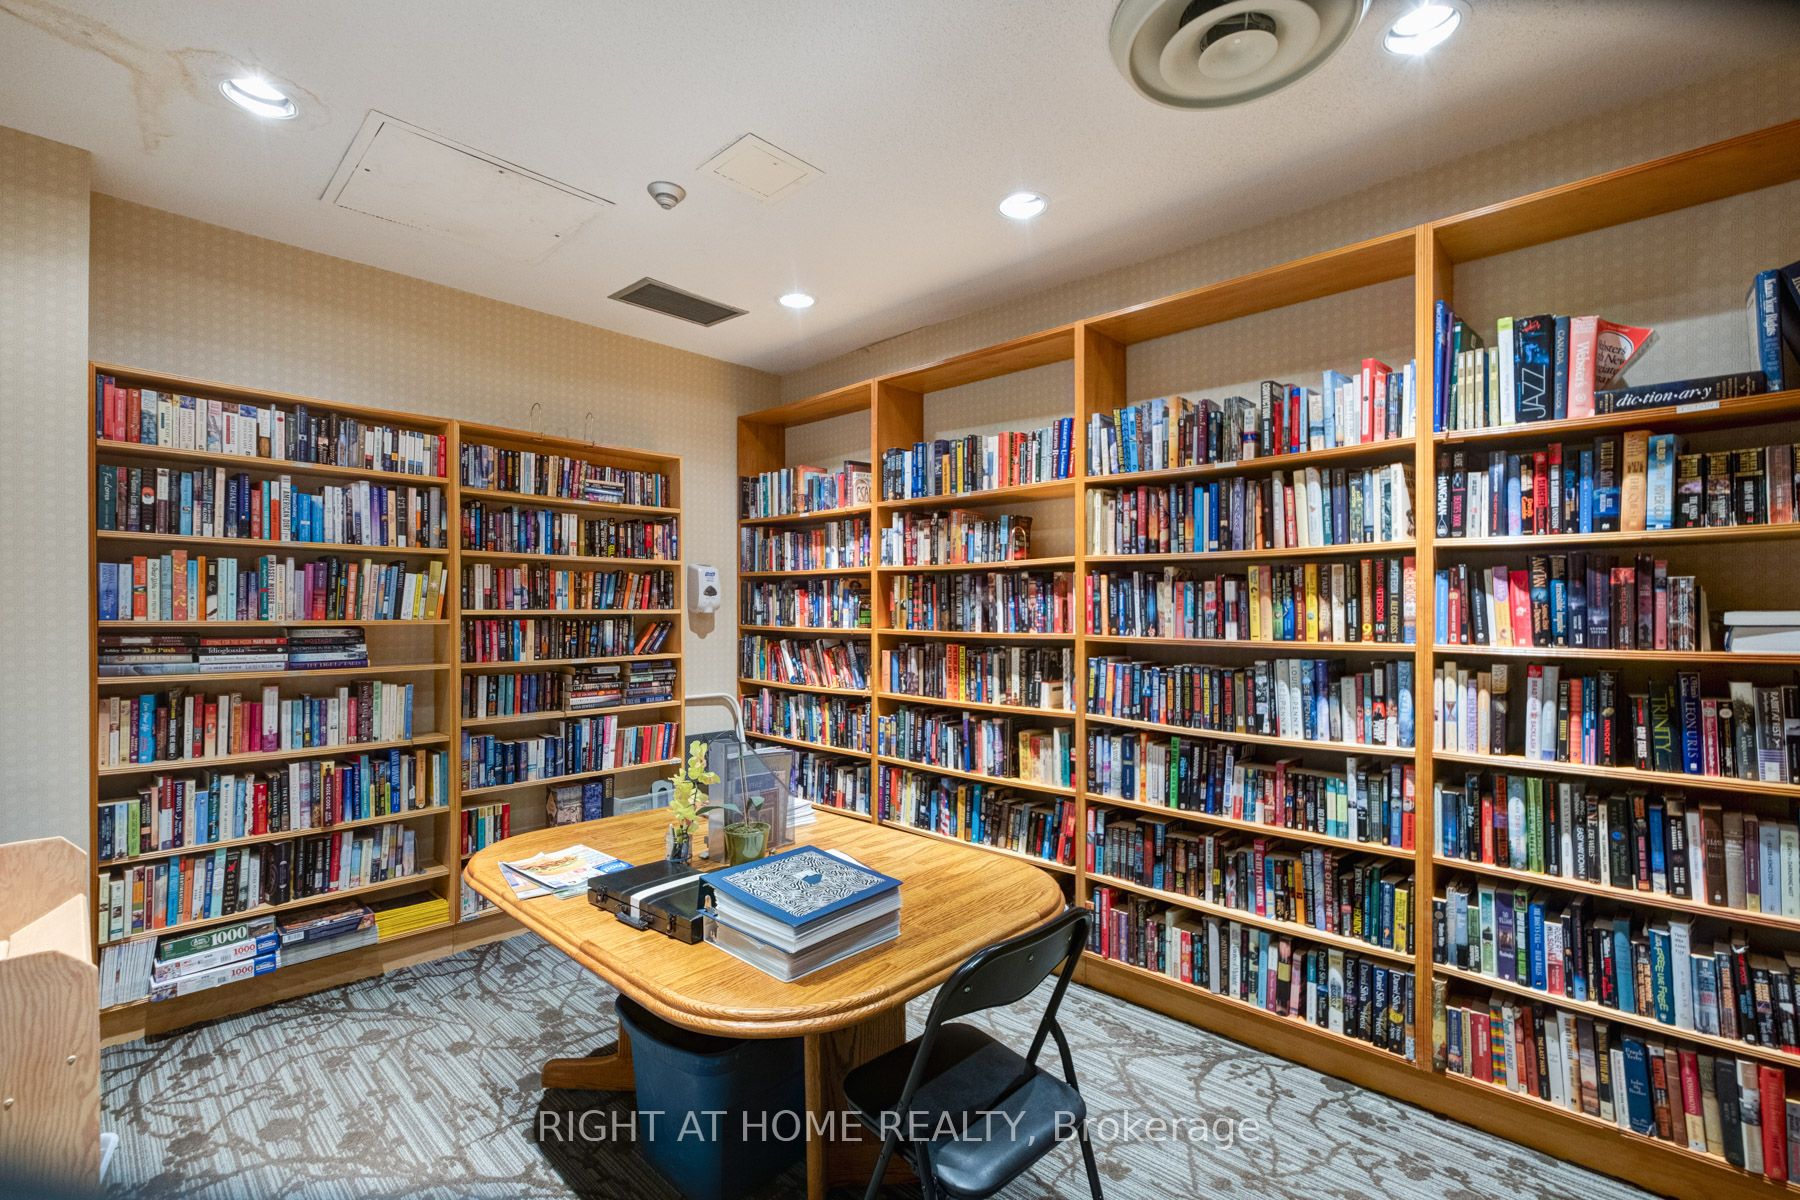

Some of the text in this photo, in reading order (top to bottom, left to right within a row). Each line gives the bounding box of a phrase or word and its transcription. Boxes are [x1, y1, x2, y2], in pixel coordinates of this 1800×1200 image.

[1764, 312, 1779, 337] Rights
[1556, 330, 1564, 364] CANADA
[1575, 341, 1590, 388] Webster's
[1262, 382, 1270, 419] CONVICTION
[1521, 365, 1546, 419] JAZZ
[1601, 441, 1614, 469] WILBUR
[1532, 557, 1547, 588] AMY TAN
[1556, 583, 1565, 611] Irresistible
[1771, 691, 1780, 713] RABBIT
[142, 712, 150, 722] Your
[142, 723, 150, 732] Life
[1652, 693, 1672, 752] TRINITY
[1685, 702, 1697, 758] LEON URIS
[1326, 904, 1332, 916] ME
[210, 926, 247, 946] 1000
[233, 943, 256, 956] 1000
[231, 965, 253, 976] 1000
[1318, 951, 1326, 985] Daniel Silva
[1655, 948, 1664, 972] FREE
[1360, 965, 1368, 1001] Daniel Silva
[1376, 970, 1384, 1007] Daniel Silva
[1392, 974, 1401, 1010] Daniel Silva
[1657, 986, 1668, 1011] FREE
